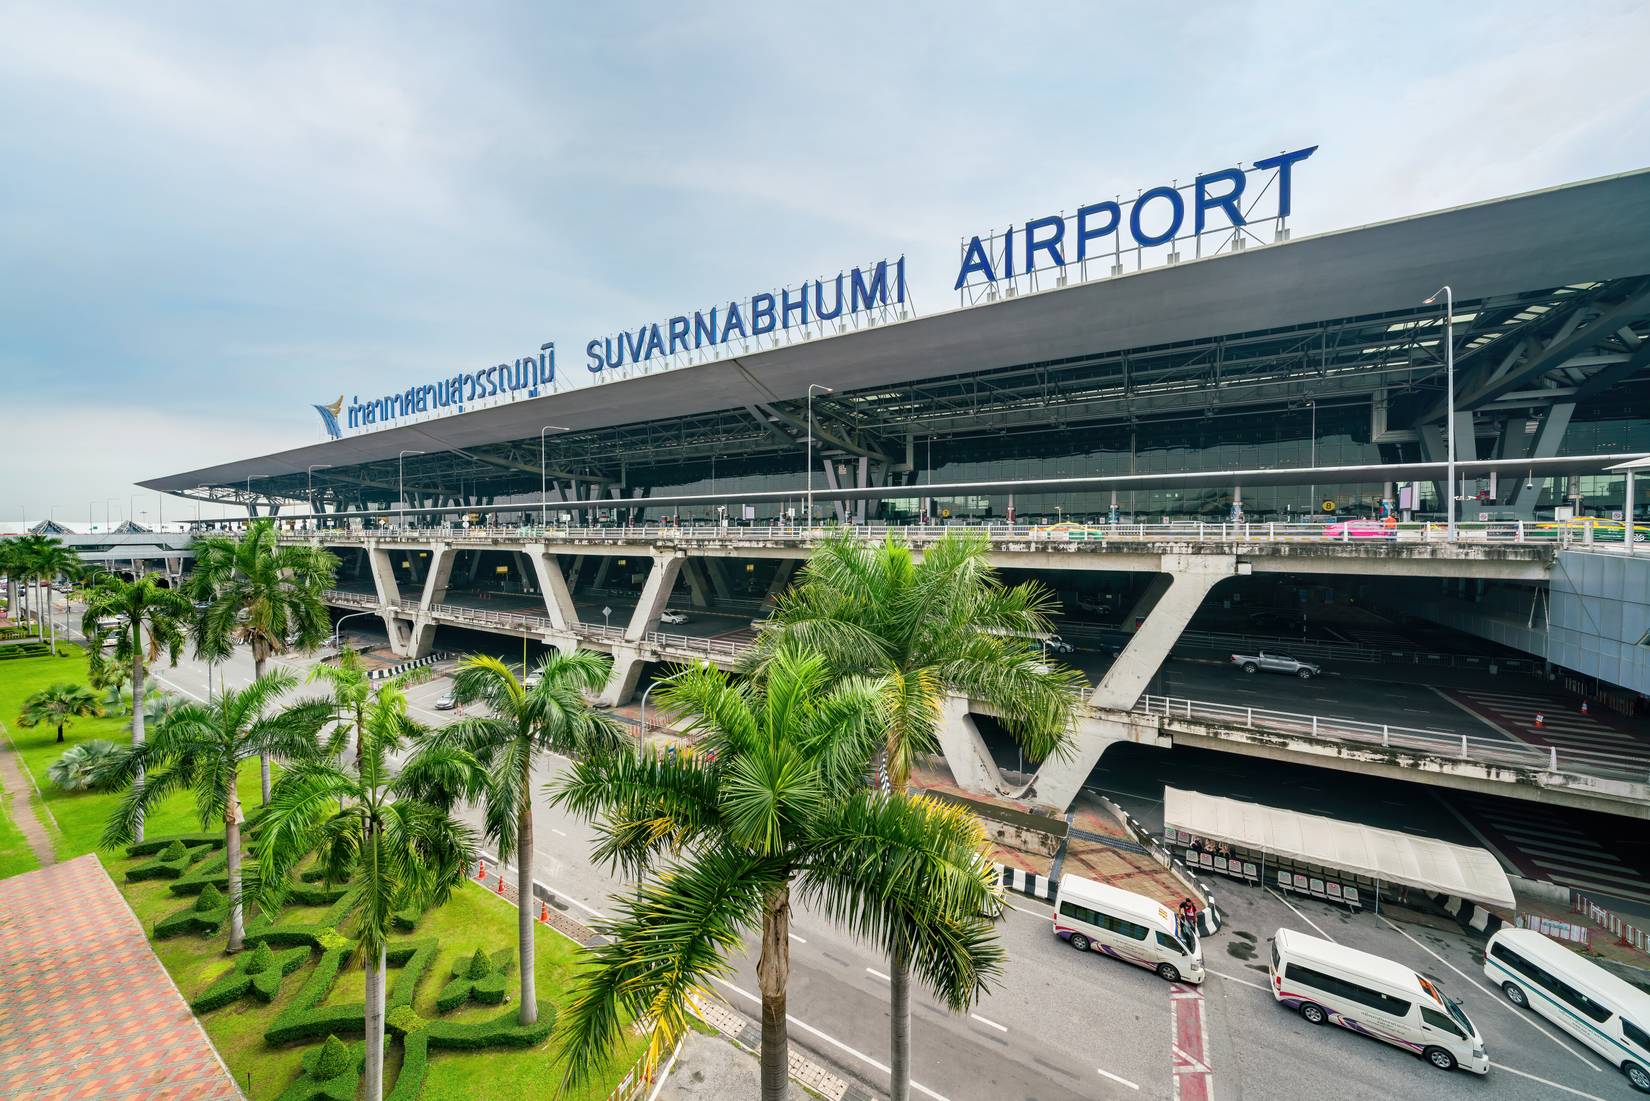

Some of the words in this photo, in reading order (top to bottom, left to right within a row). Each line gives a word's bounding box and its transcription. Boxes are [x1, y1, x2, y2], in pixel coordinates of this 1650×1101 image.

[587, 255, 905, 373] SUVARNABHUMI
[954, 145, 1319, 290] AIRPORT
[348, 342, 555, 428] ท่าอากาศยานสุวรรณภูมิ
